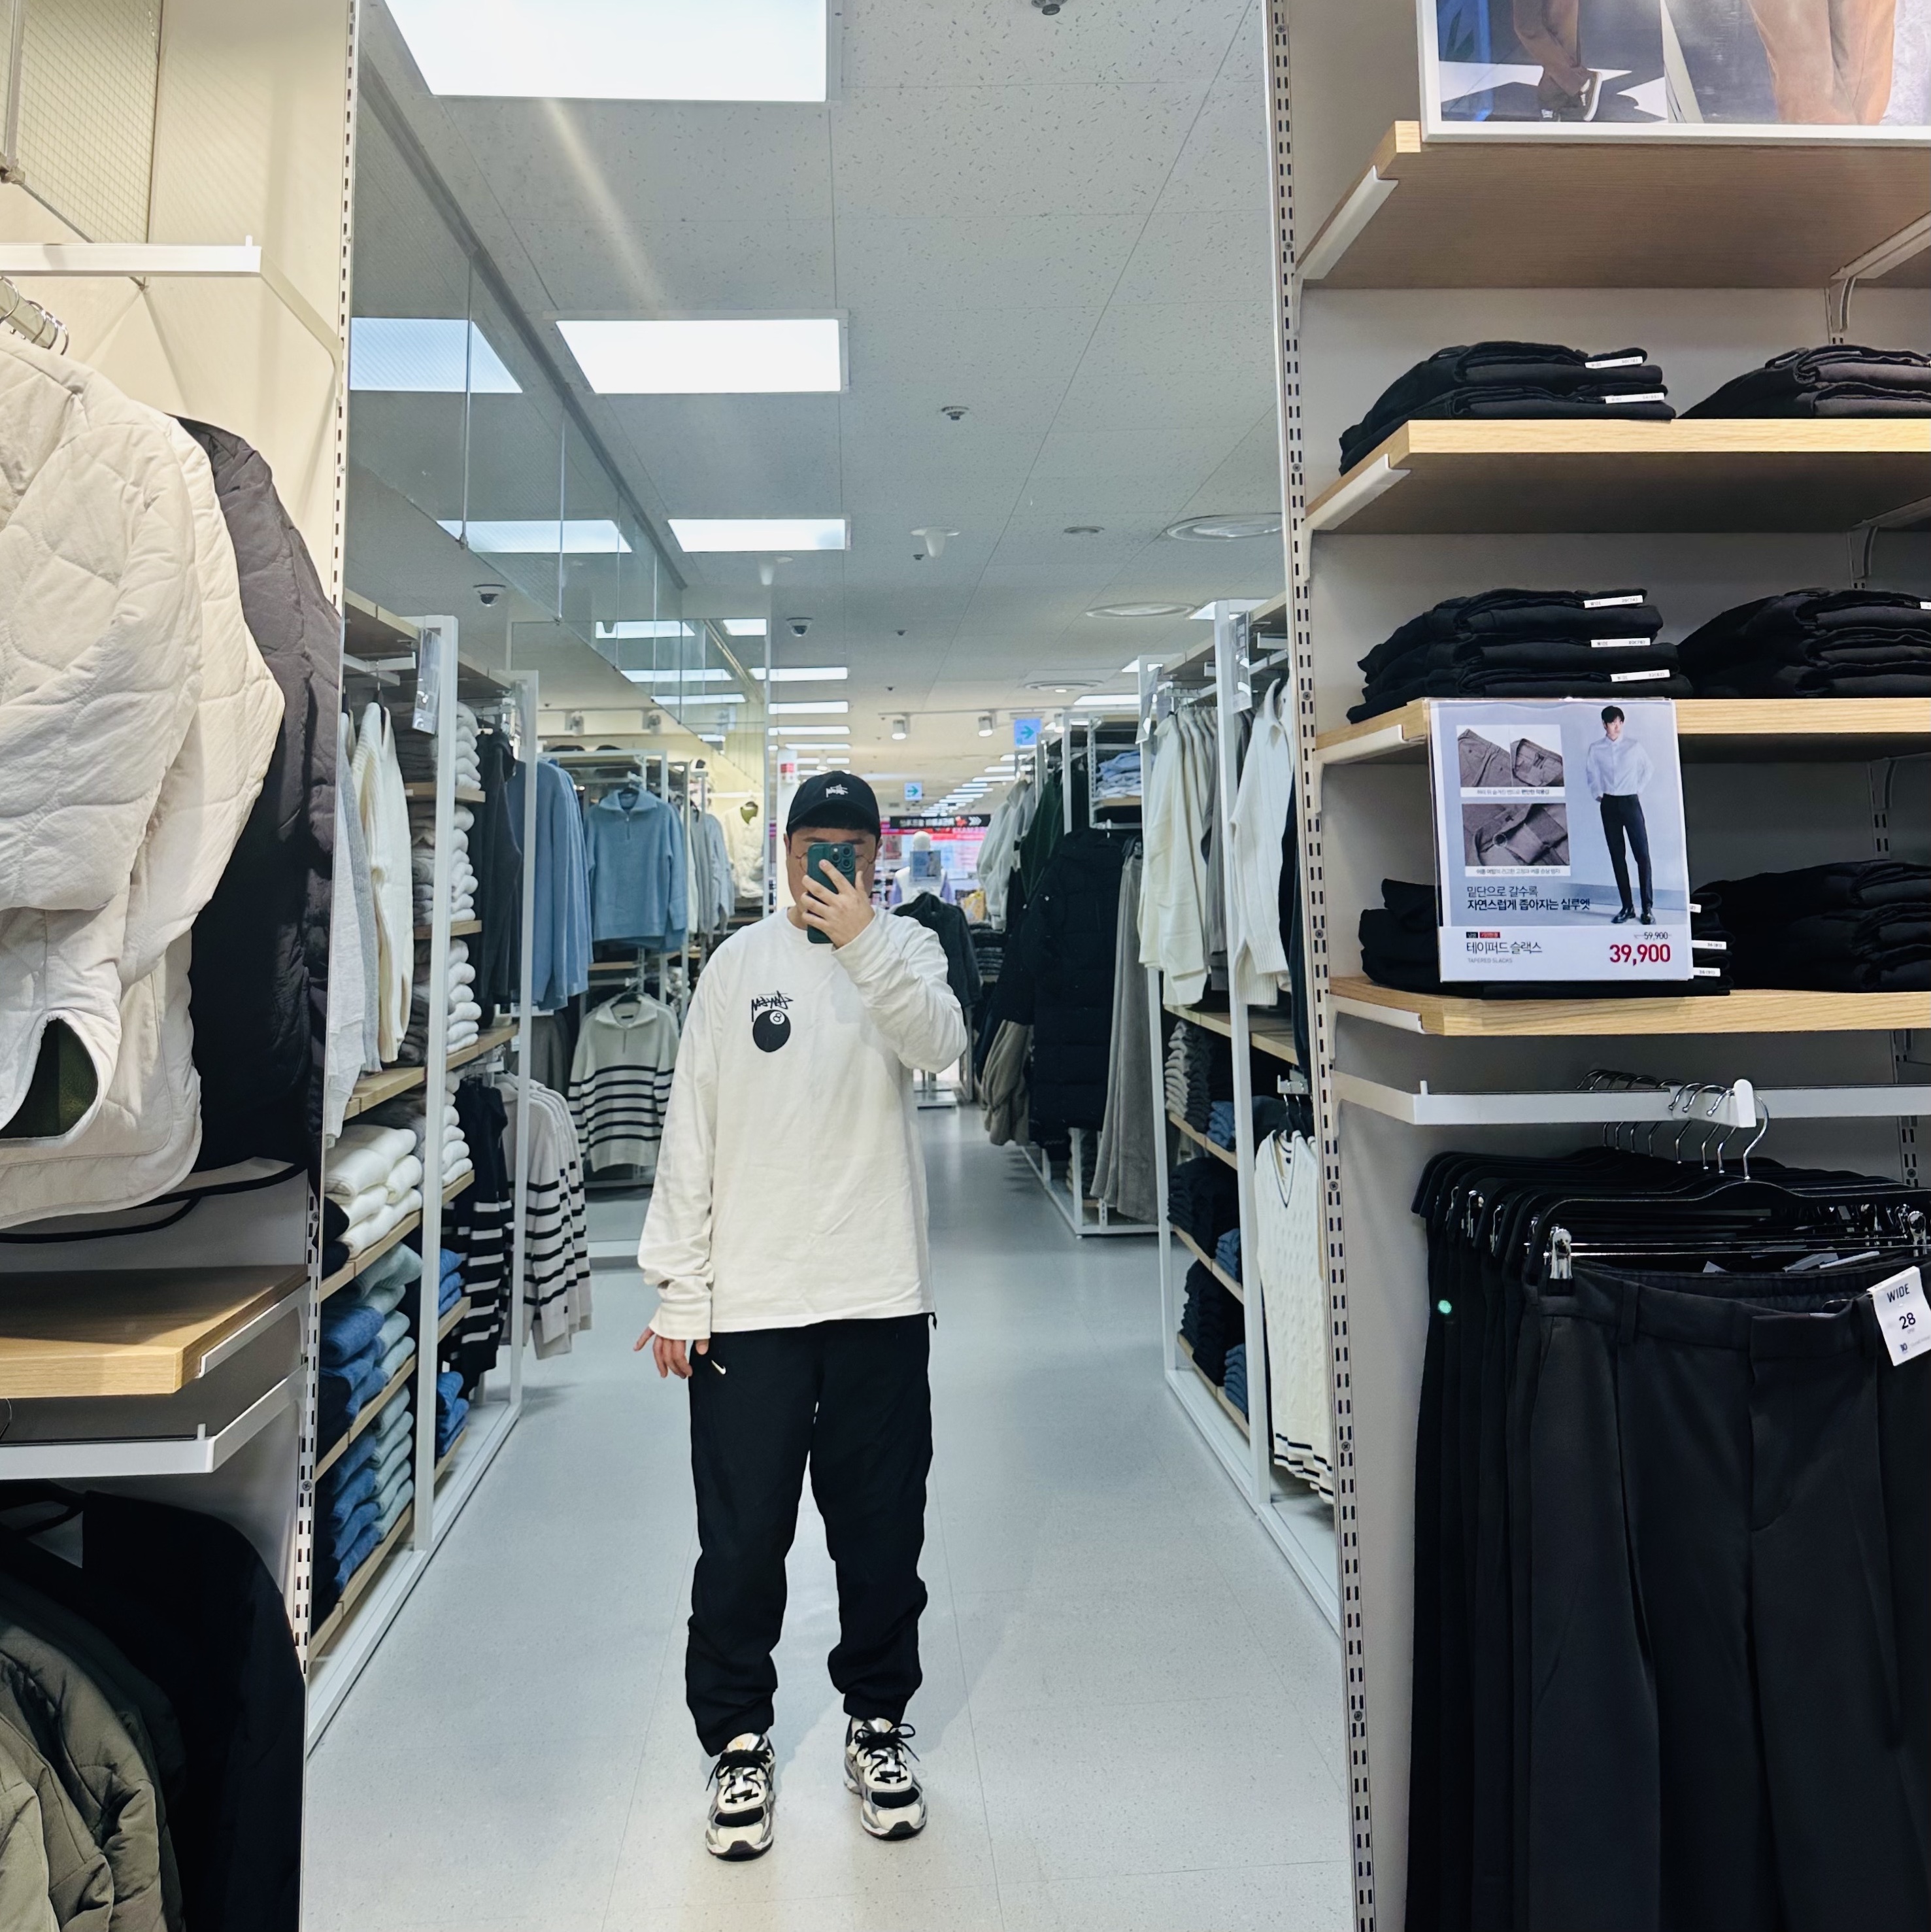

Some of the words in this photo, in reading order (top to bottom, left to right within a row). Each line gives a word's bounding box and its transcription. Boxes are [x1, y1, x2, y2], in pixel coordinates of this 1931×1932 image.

[1467, 886, 1507, 898] 밑단으로
[1509, 885, 1539, 898] 갈수록
[1467, 899, 1517, 911] 자연스럽게
[1519, 898, 1559, 911] 좁아지는
[1560, 898, 1590, 911] 실루엣
[1643, 931, 1668, 941] 59,900
[1466, 941, 1509, 955] 테이퍼드
[1510, 941, 1543, 955] 슬랙스
[1609, 943, 1671, 966] 39,900
[1887, 1283, 1910, 1303] WIDE
[1899, 1312, 1916, 1330] 28
